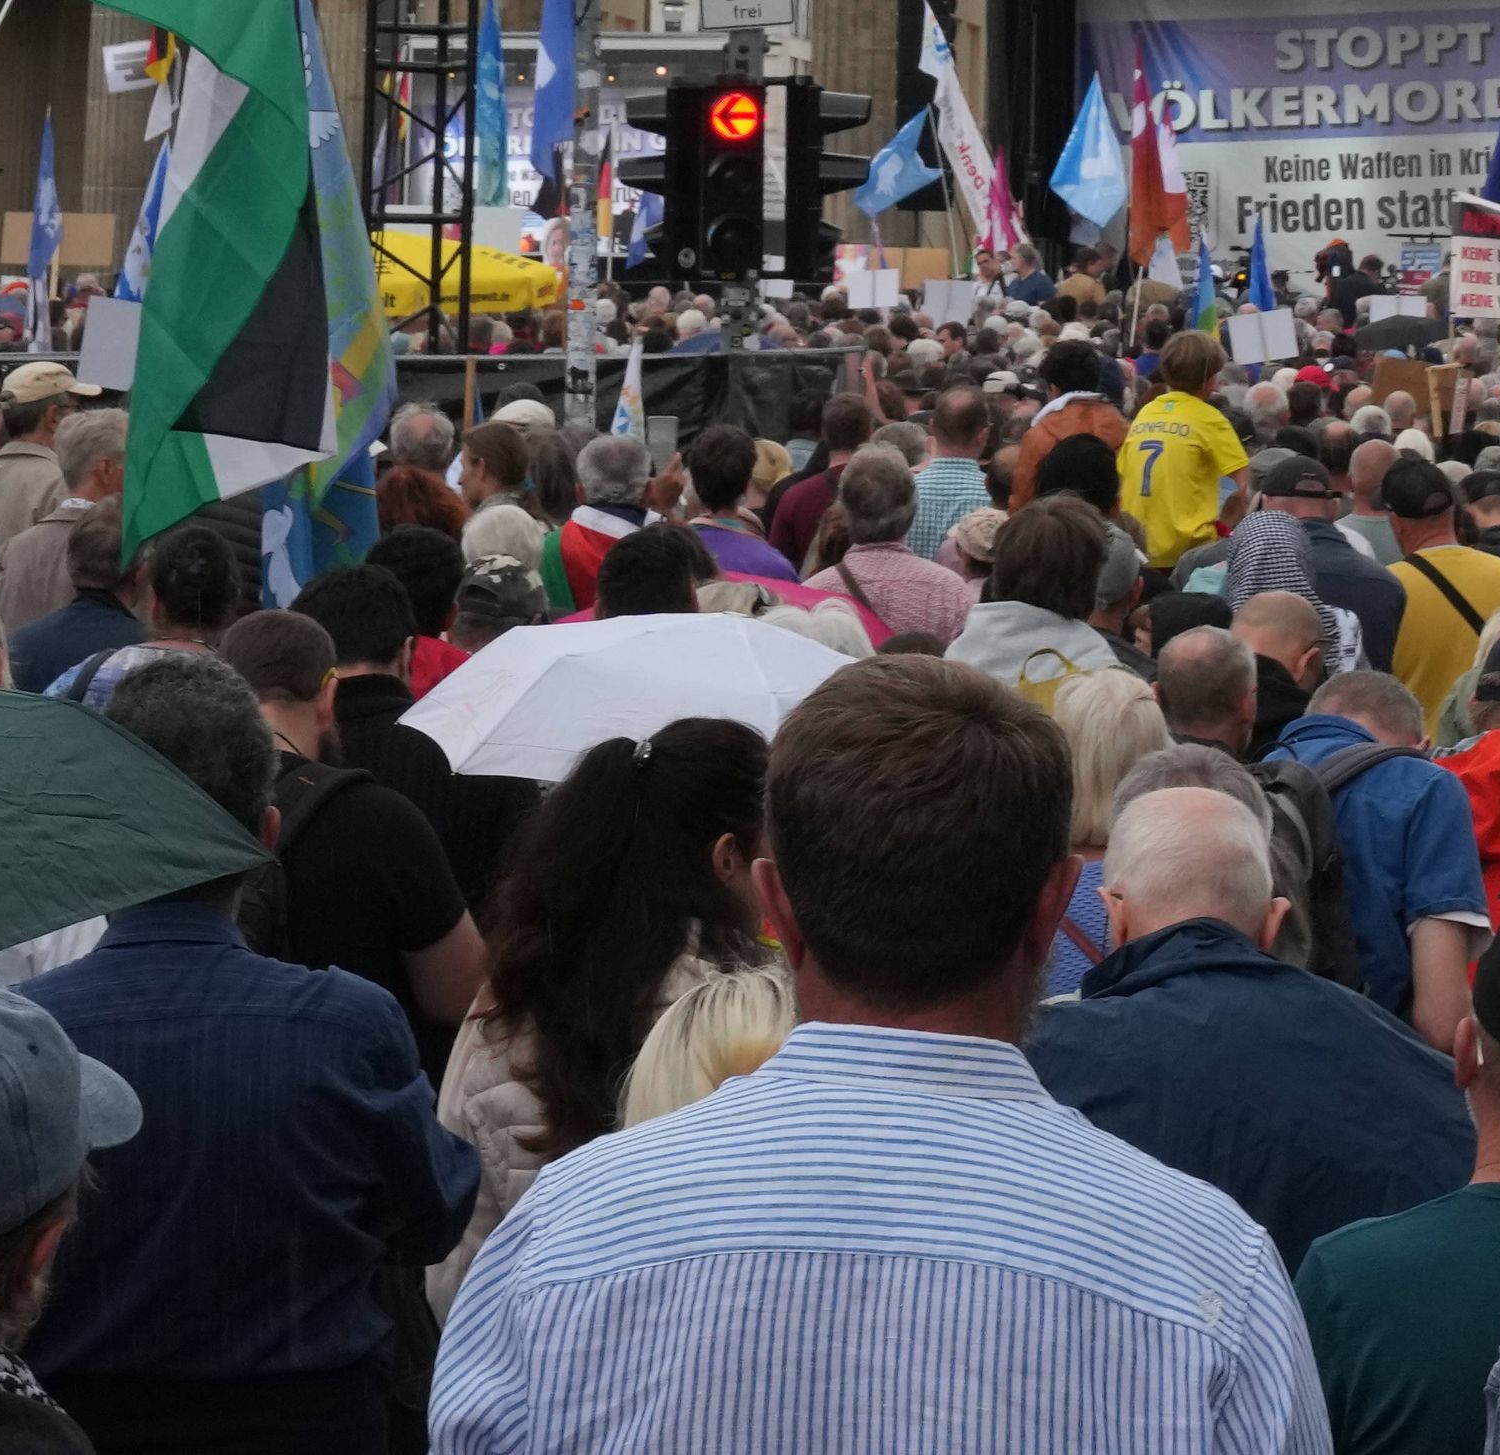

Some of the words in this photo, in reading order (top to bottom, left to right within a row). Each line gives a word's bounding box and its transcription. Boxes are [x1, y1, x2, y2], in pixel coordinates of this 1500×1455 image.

[732, 5, 762, 20] frei
[1274, 20, 1493, 71] STOPPT
[1265, 154, 1332, 184] Keine
[1339, 149, 1423, 181] Waffen
[1430, 148, 1452, 177] in
[1237, 193, 1366, 234] Frieden
[1460, 246, 1493, 262] KEINE
[1460, 270, 1493, 286] KEINE
[1460, 293, 1494, 309] KEINE
[1138, 439, 1165, 497] 7
